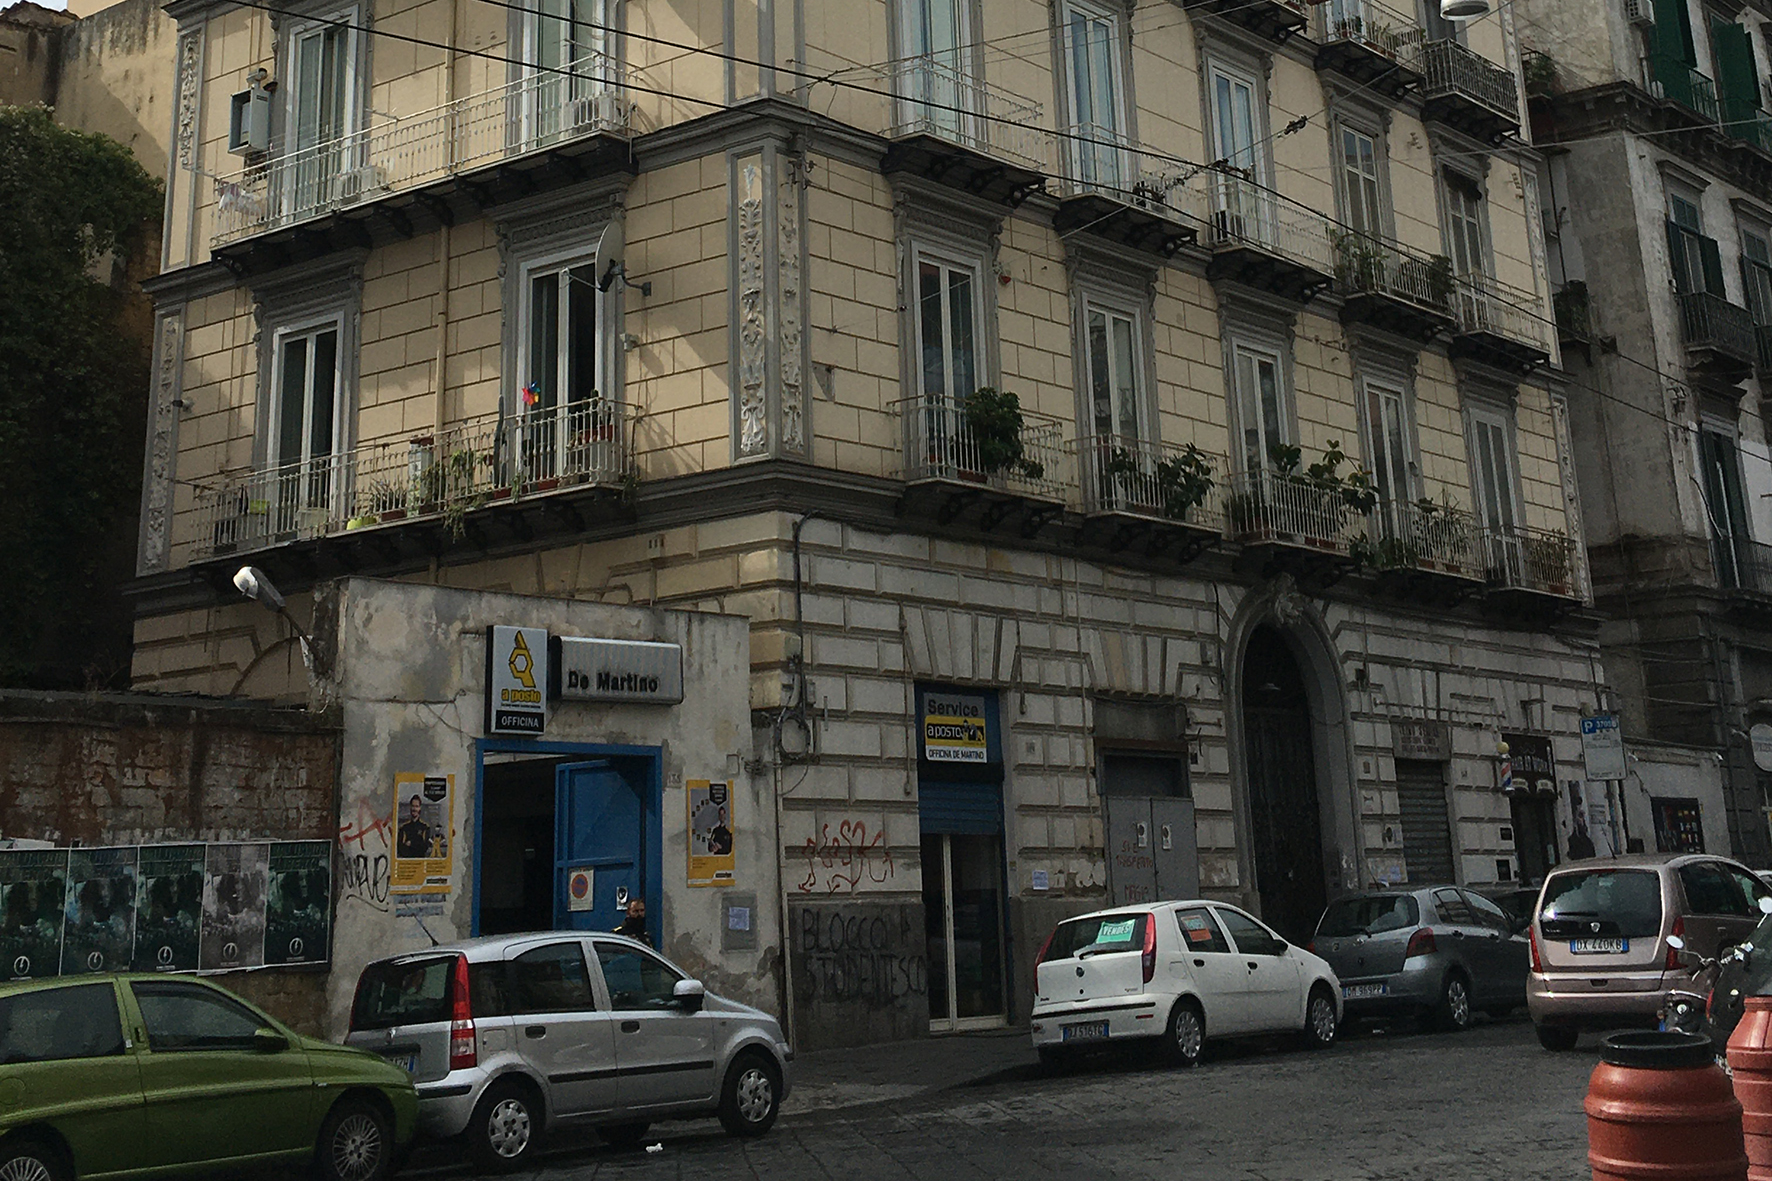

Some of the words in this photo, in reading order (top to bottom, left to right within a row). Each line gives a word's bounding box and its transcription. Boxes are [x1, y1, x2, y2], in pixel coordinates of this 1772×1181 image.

[596, 672, 659, 693] Martino
[501, 689, 509, 701] a
[511, 689, 541, 704] posto
[928, 699, 979, 717] Service
[501, 715, 539, 728] OFFICINA
[928, 749, 952, 758] OFFICINA
[953, 750, 960, 759] DE
[961, 750, 985, 760] MARTINO
[802, 908, 887, 952] BLOCCO
